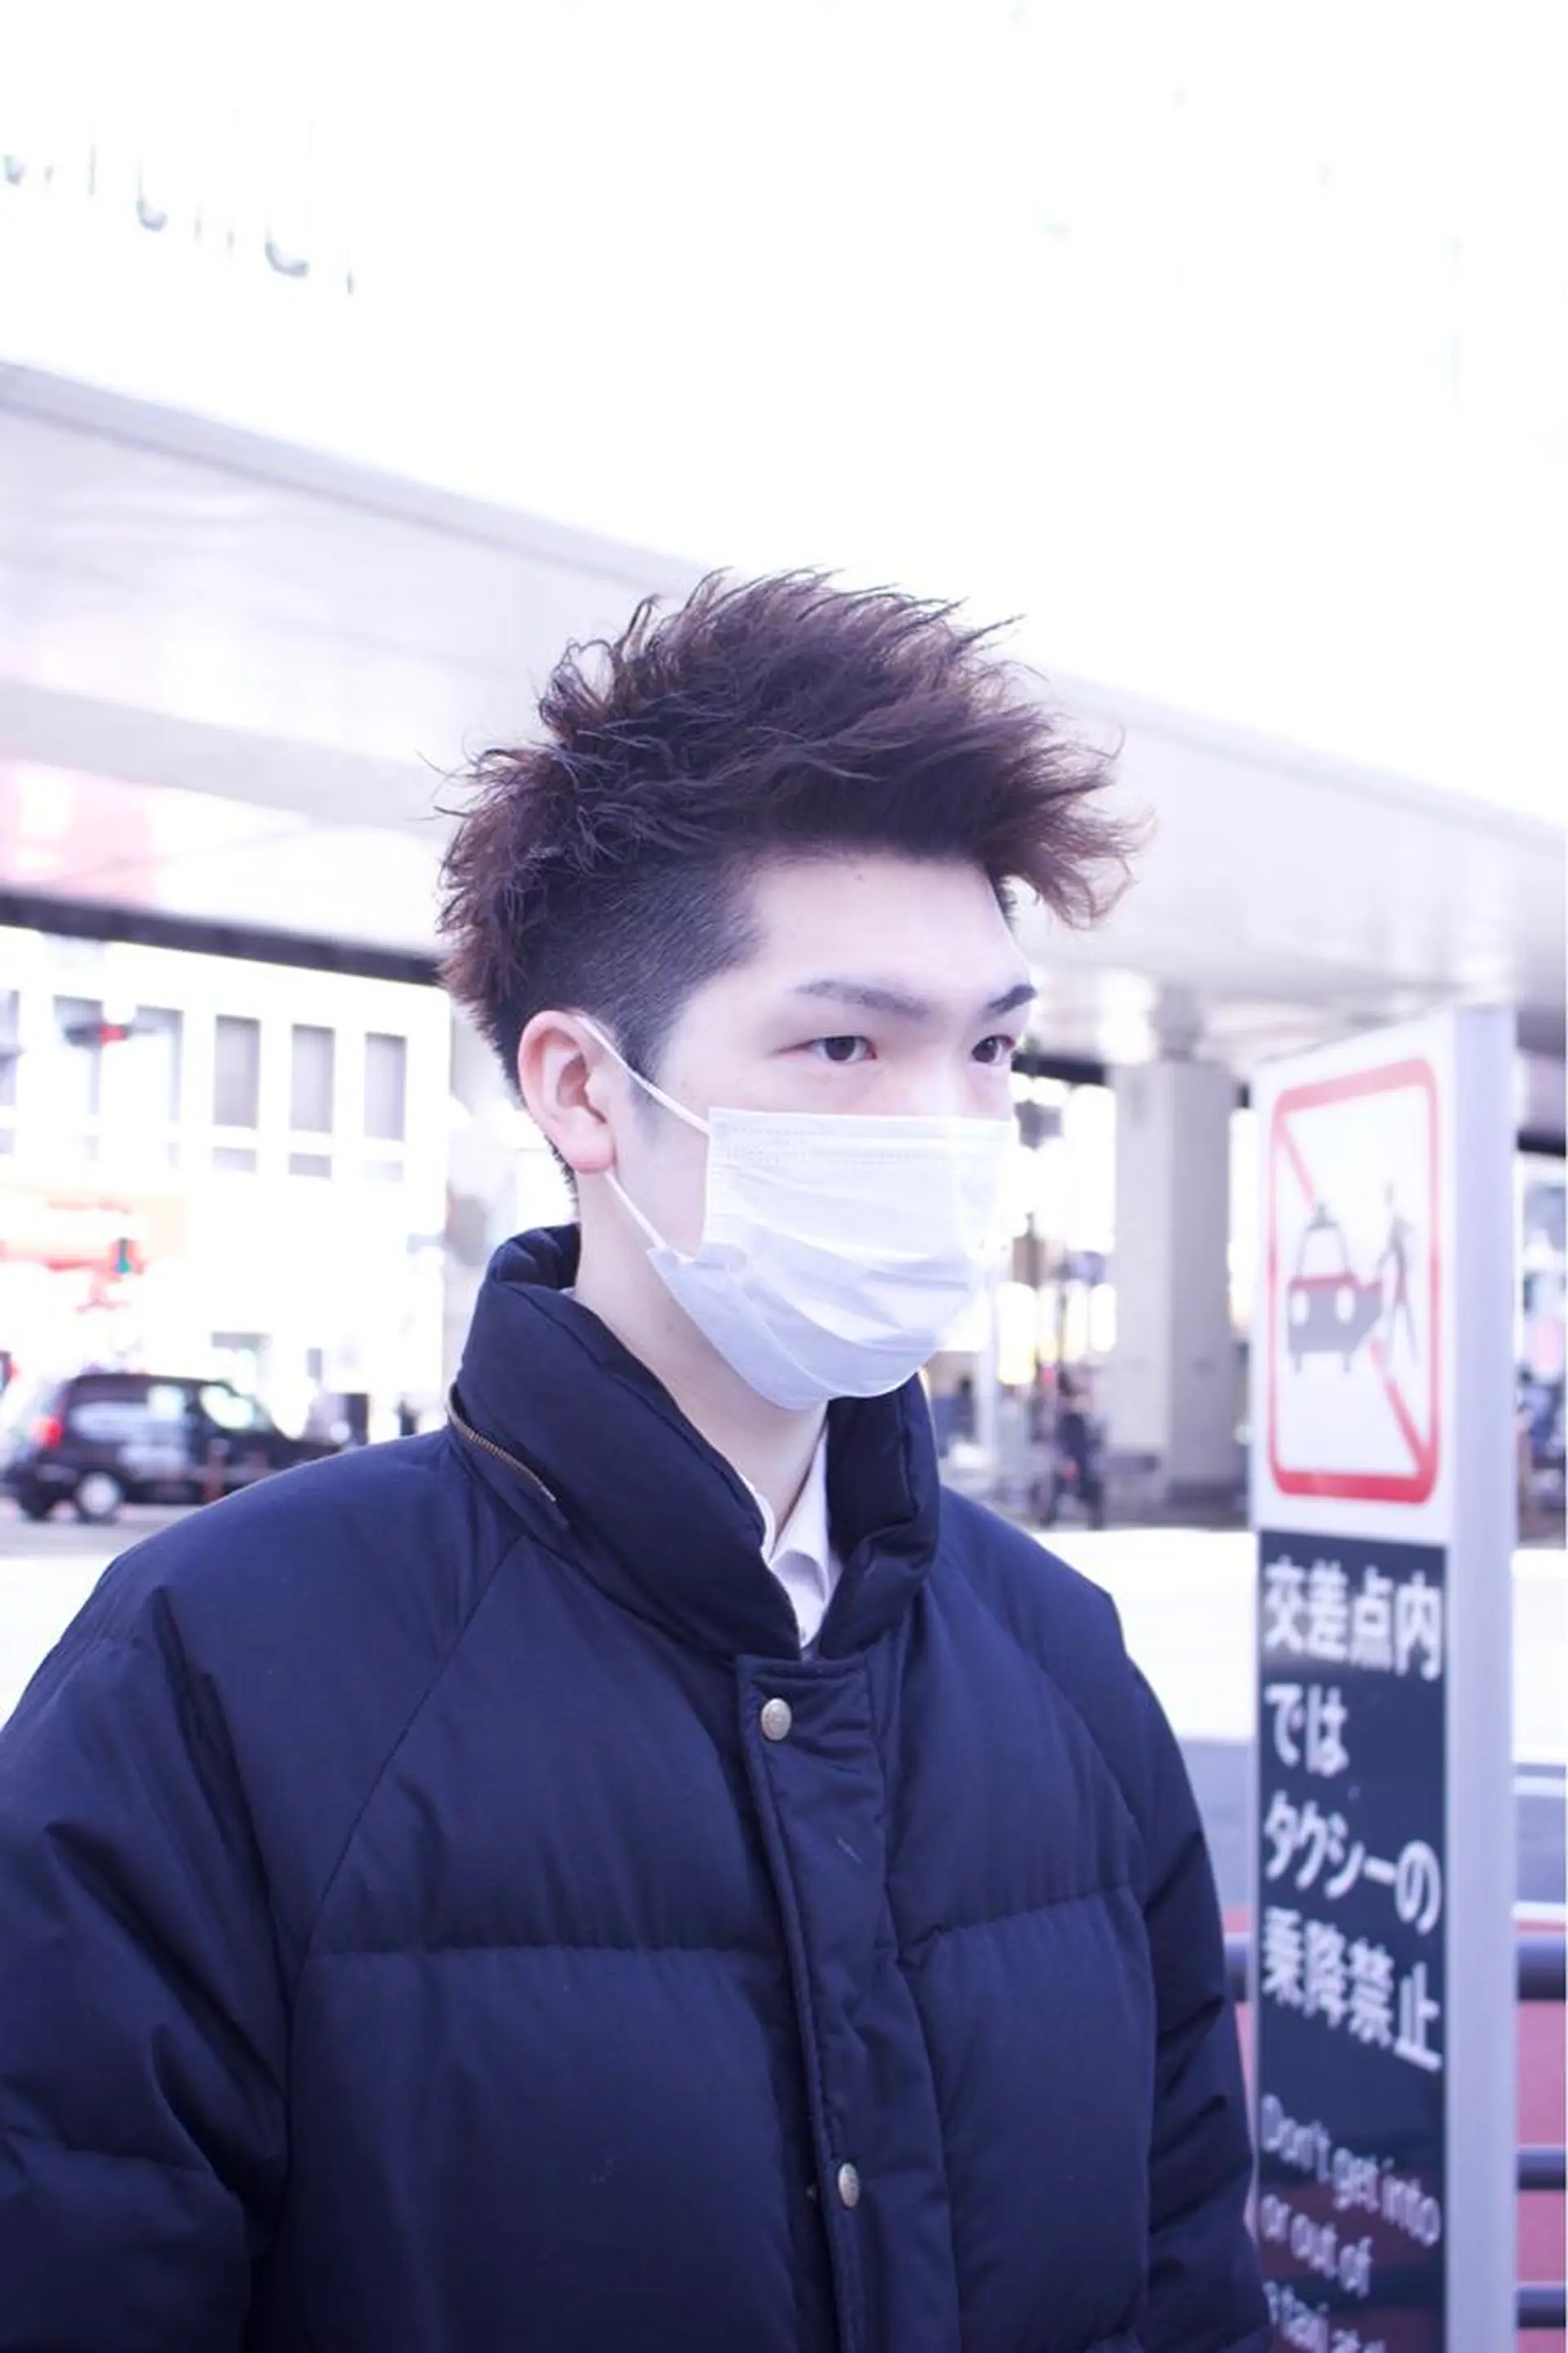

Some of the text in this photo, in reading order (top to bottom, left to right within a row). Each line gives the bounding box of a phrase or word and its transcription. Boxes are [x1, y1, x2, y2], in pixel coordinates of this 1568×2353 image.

[1263, 1553, 1443, 1682] 交差点内
[1263, 1682, 1351, 1778] では
[1263, 1789, 1443, 1937] タクシーの
[1262, 1905, 1443, 2074] 乗降禁止
[1261, 2093, 1441, 2247] Don't get into
[1261, 2193, 1373, 2298] or out of
